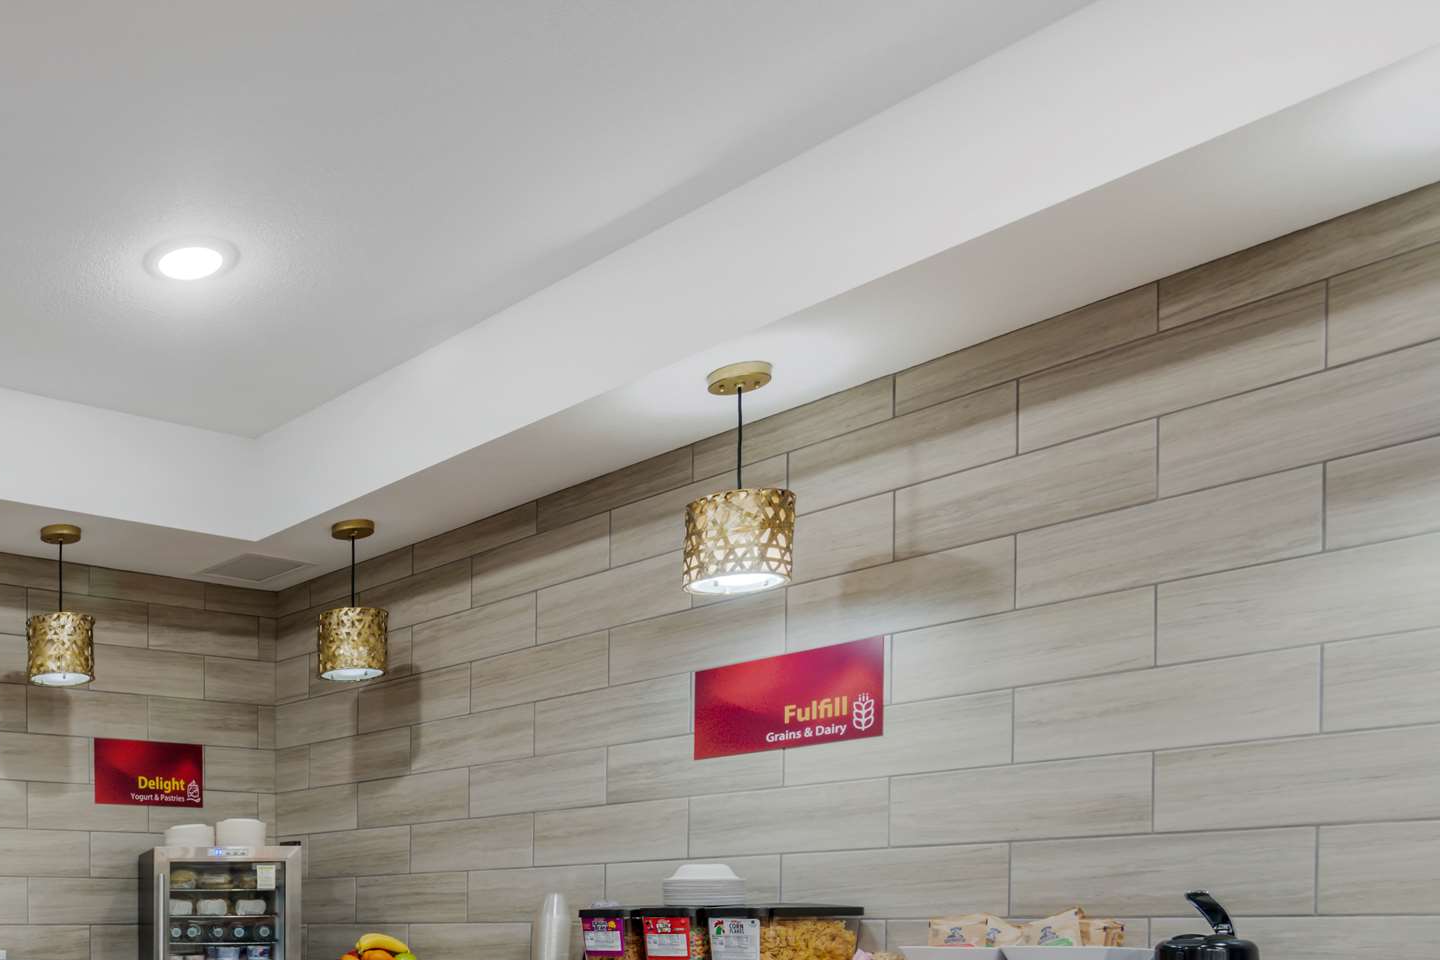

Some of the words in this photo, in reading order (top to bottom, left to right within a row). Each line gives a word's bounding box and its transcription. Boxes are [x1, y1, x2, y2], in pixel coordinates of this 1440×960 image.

[783, 695, 849, 725] Fulfill
[765, 730, 802, 744] Grains
[803, 726, 814, 738] &
[815, 723, 848, 737] Dairy
[137, 775, 186, 794] Delight
[130, 792, 154, 802] Yogurt
[160, 793, 185, 803] Pastries
